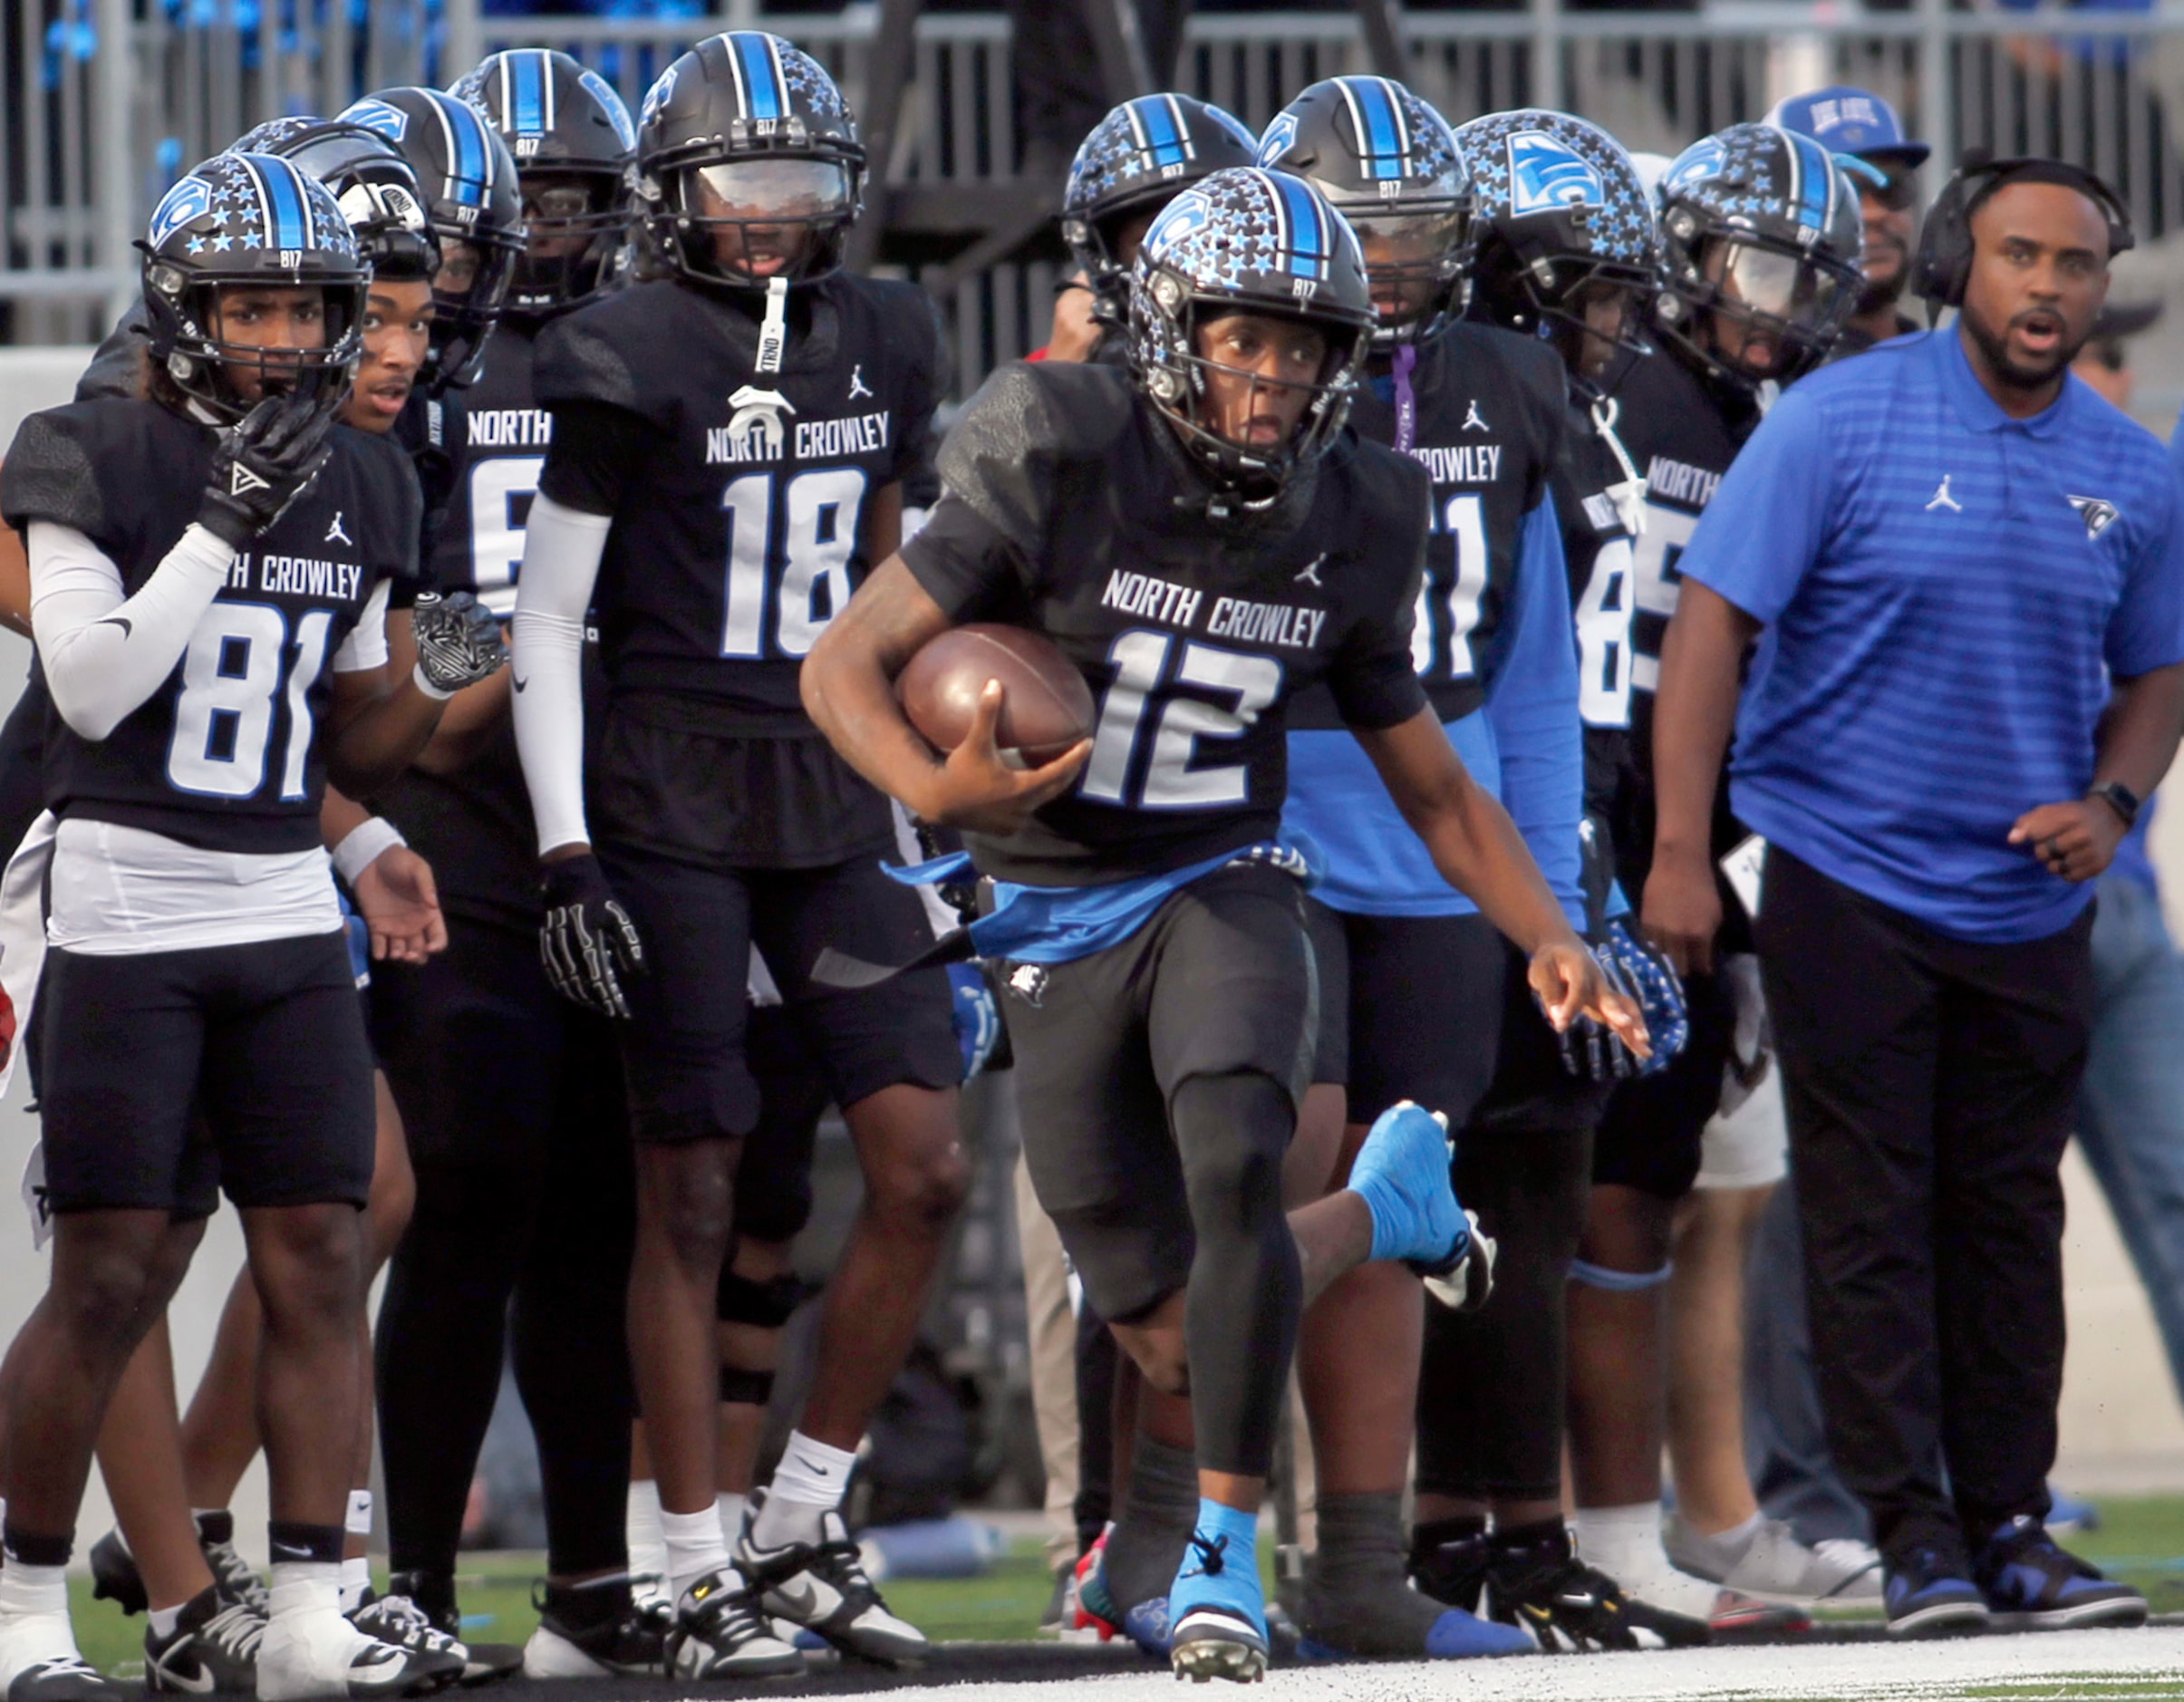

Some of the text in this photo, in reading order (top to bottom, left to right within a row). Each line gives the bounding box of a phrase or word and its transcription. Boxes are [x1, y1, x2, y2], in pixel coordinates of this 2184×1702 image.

[756, 119, 777, 135] 817
[516, 138, 539, 157] 817
[1378, 180, 1402, 198] 817
[456, 205, 479, 223] 817
[1796, 224, 1821, 246] 817
[279, 249, 303, 269] 817
[1292, 277, 1318, 297] 817
[467, 409, 554, 447] NORTH
[794, 410, 890, 459] CROWLEY
[1410, 445, 1501, 483] ROWLEY
[1647, 454, 1722, 506] NORTH
[261, 554, 362, 601] CROWLEY
[719, 465, 868, 662] 18
[1100, 568, 1327, 649] NORTH CROWLEY
[164, 597, 336, 803] 81
[1077, 627, 1285, 810] 12
